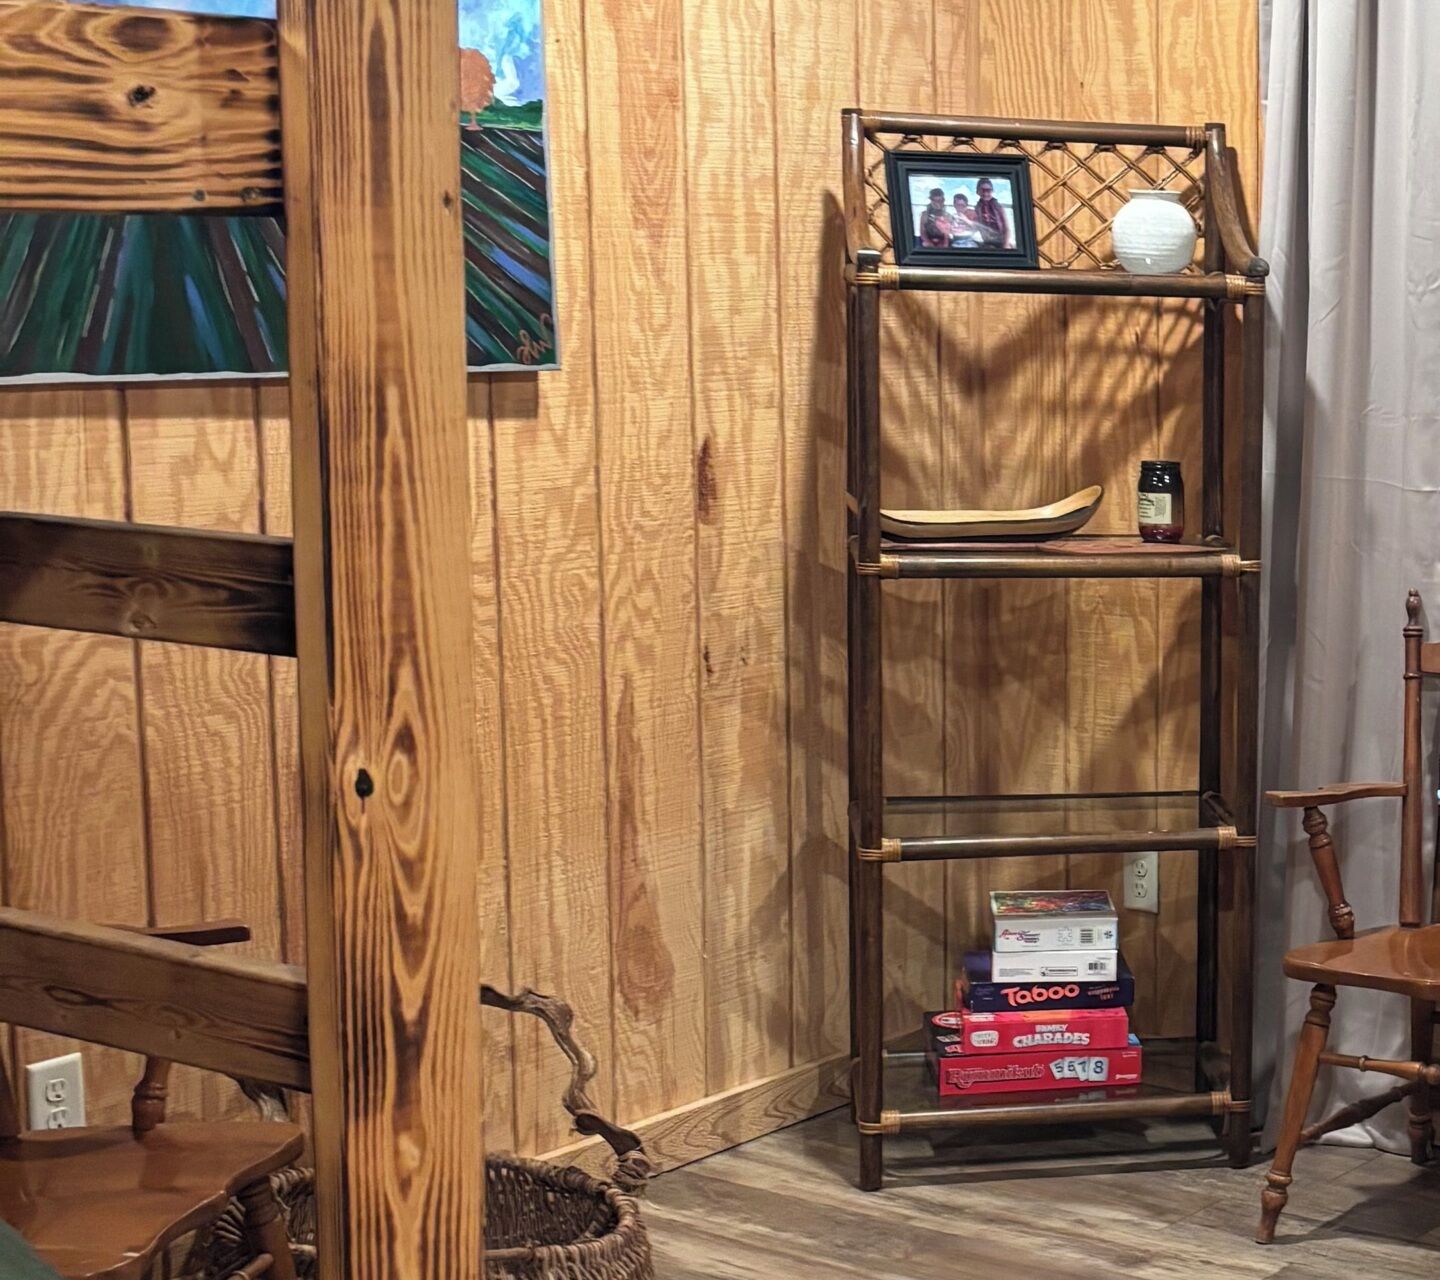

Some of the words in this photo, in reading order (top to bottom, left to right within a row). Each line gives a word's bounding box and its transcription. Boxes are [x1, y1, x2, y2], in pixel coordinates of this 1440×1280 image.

[1001, 984, 1080, 1007] Taboo
[1013, 1032, 1091, 1049] CHARADES
[1055, 1063, 1064, 1073] 5
[1068, 1061, 1076, 1071] 5
[1093, 1061, 1103, 1074] 8
